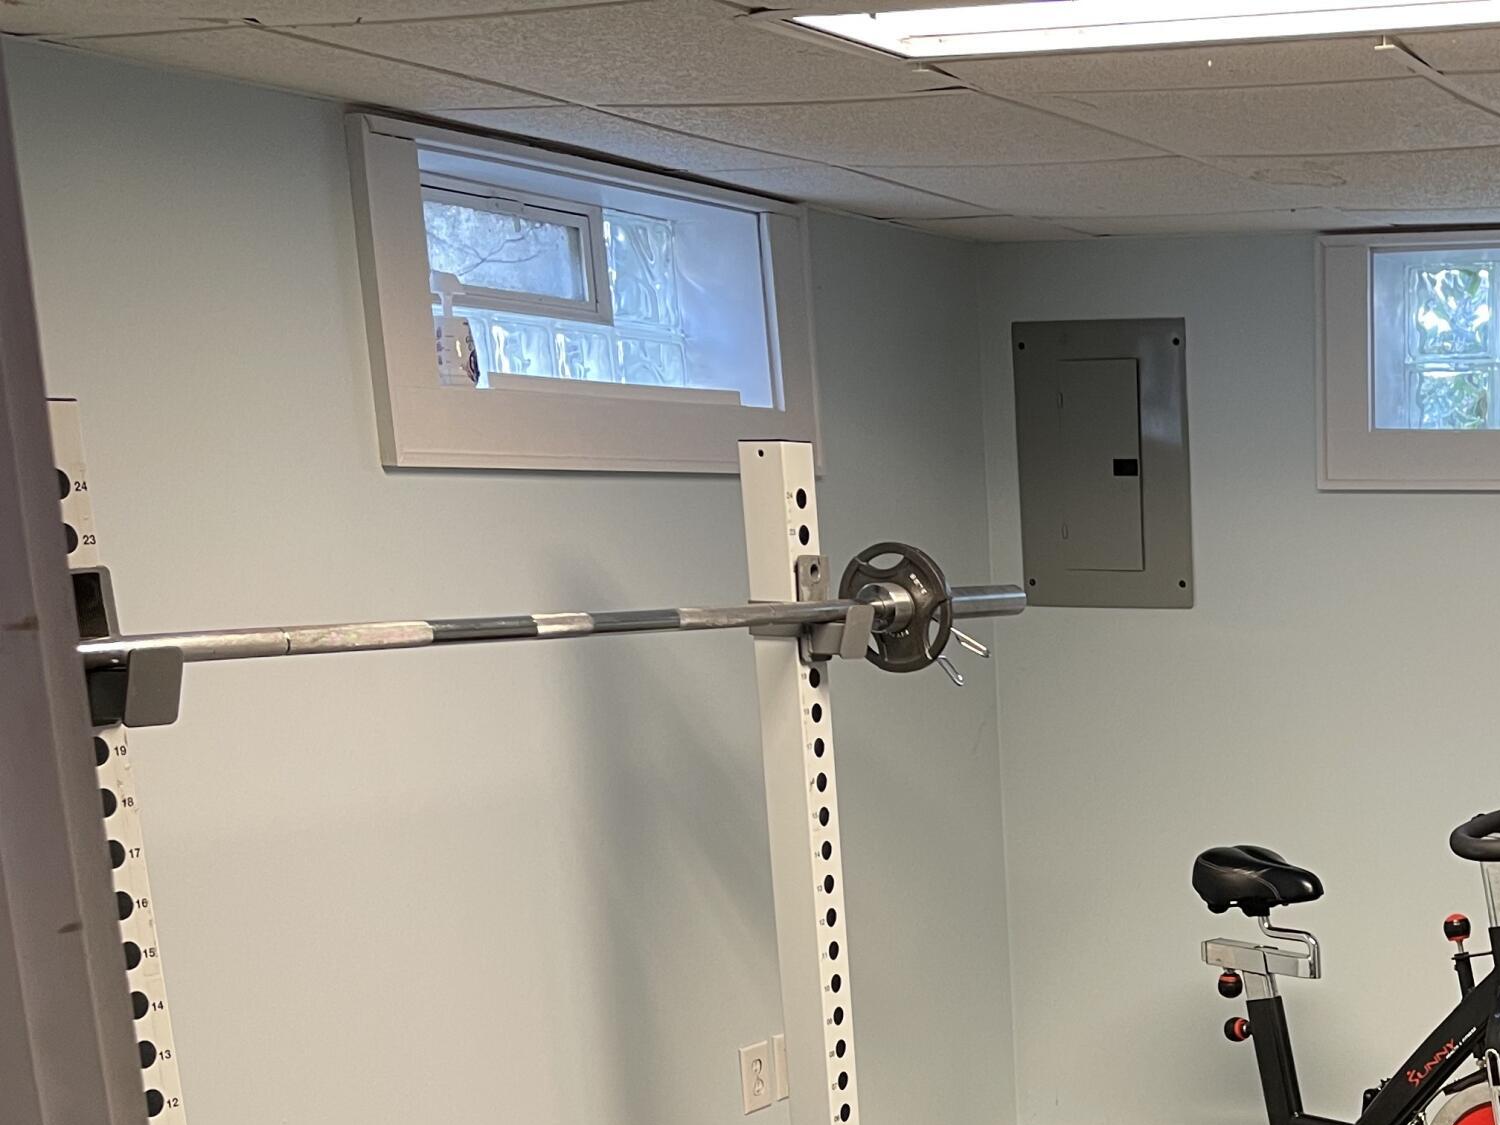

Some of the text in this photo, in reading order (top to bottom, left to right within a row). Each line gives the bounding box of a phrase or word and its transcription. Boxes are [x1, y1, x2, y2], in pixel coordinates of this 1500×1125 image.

[74, 481, 88, 492] 24
[82, 535, 96, 545] 23
[114, 745, 127, 757] 19
[121, 797, 134, 808] 18
[128, 848, 141, 859] 17
[135, 898, 148, 909] 16
[143, 948, 156, 959] 15
[151, 1001, 164, 1012] 14
[158, 1049, 171, 1061] 13
[166, 1097, 179, 1108] 12
